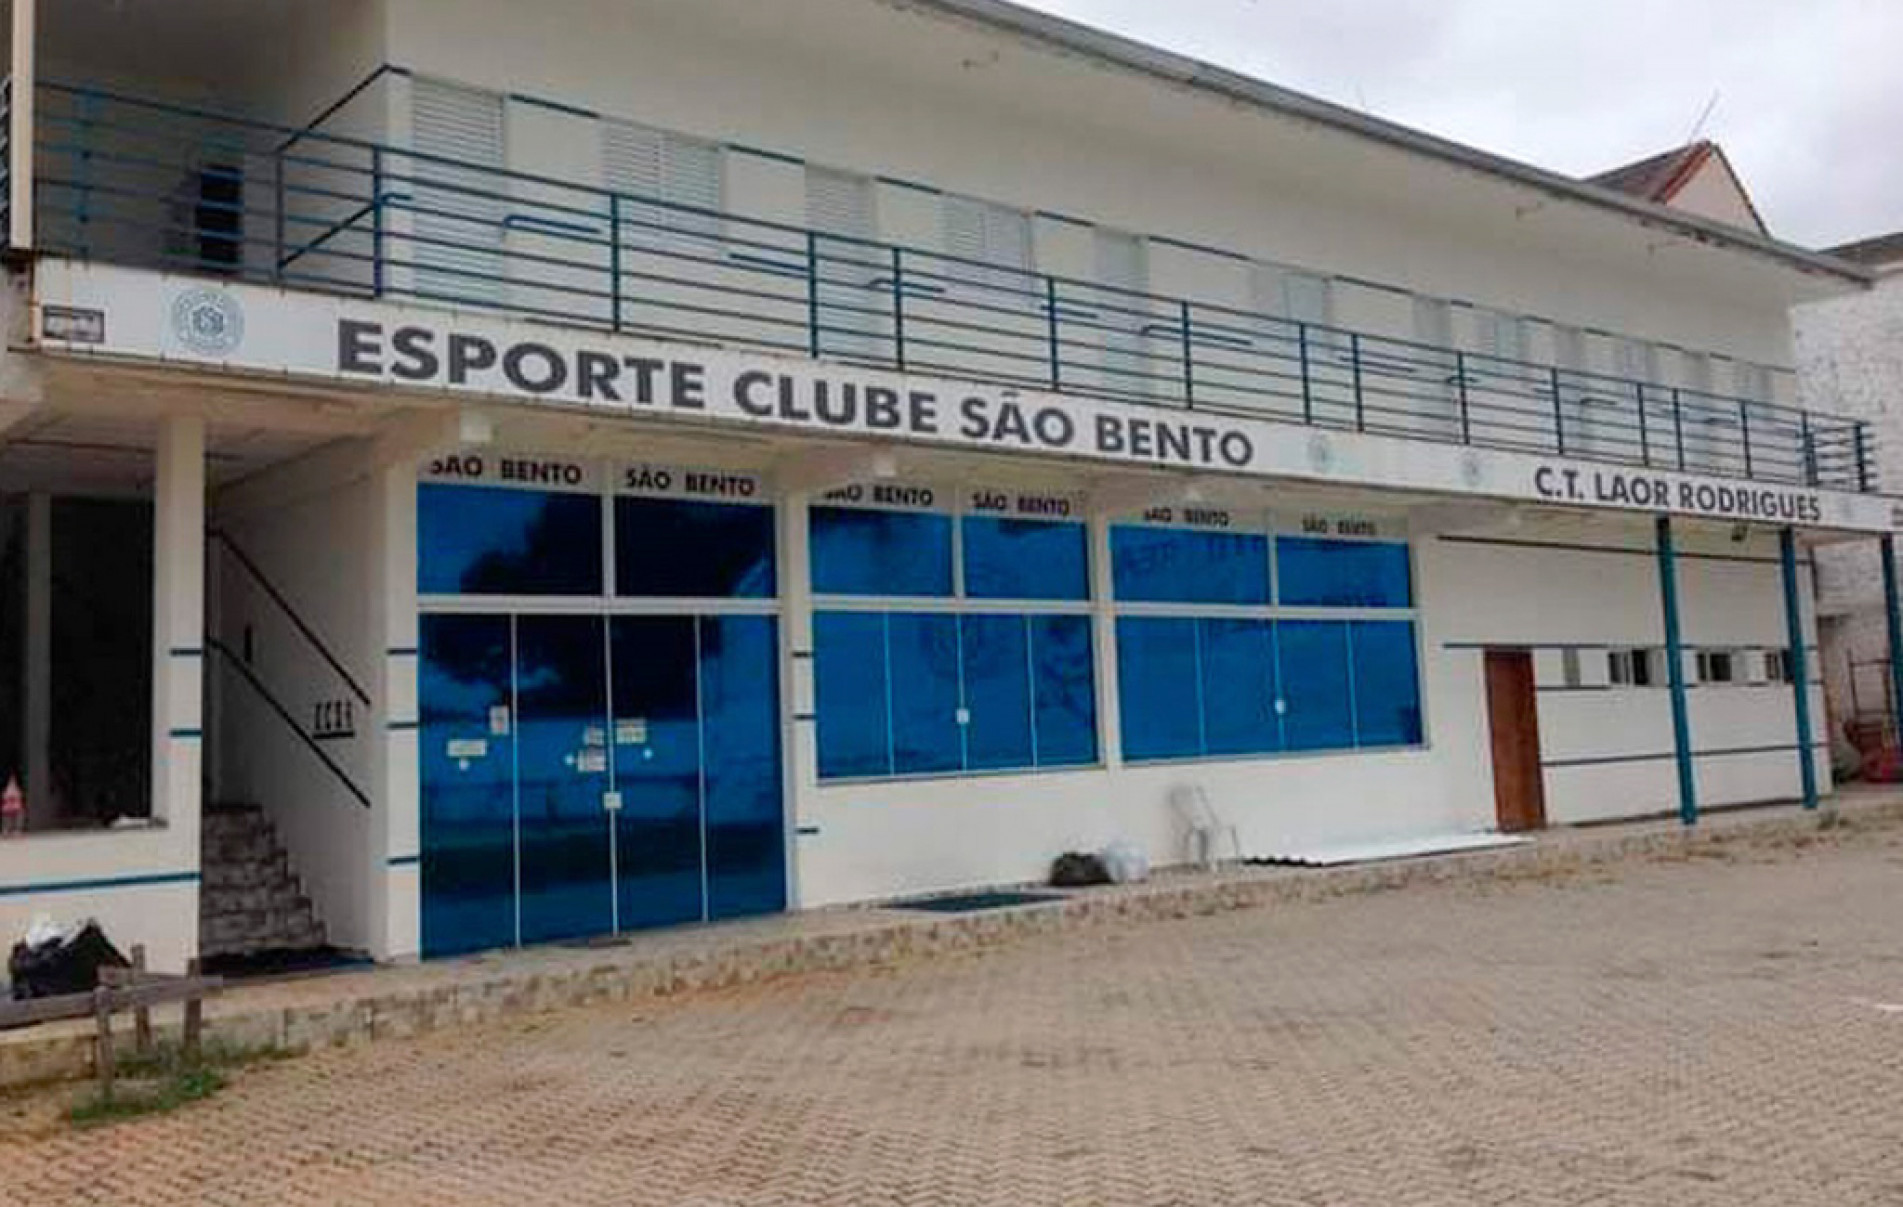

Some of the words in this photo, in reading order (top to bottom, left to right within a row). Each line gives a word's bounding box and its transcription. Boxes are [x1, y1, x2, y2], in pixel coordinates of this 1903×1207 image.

[338, 318, 705, 409] ESPORTE
[732, 369, 938, 433] CLUBE
[959, 389, 1075, 448] SÃO
[1095, 415, 1255, 469] BENTO
[501, 458, 583, 485] BENTO
[626, 464, 671, 489] SÃO
[685, 471, 754, 496] BENTO
[874, 485, 933, 506] BENTO
[1017, 495, 1070, 517] BENTO
[1534, 467, 1584, 501] C.T.
[1595, 472, 1670, 507] LAOR
[1679, 481, 1822, 521] RODRIGUES
